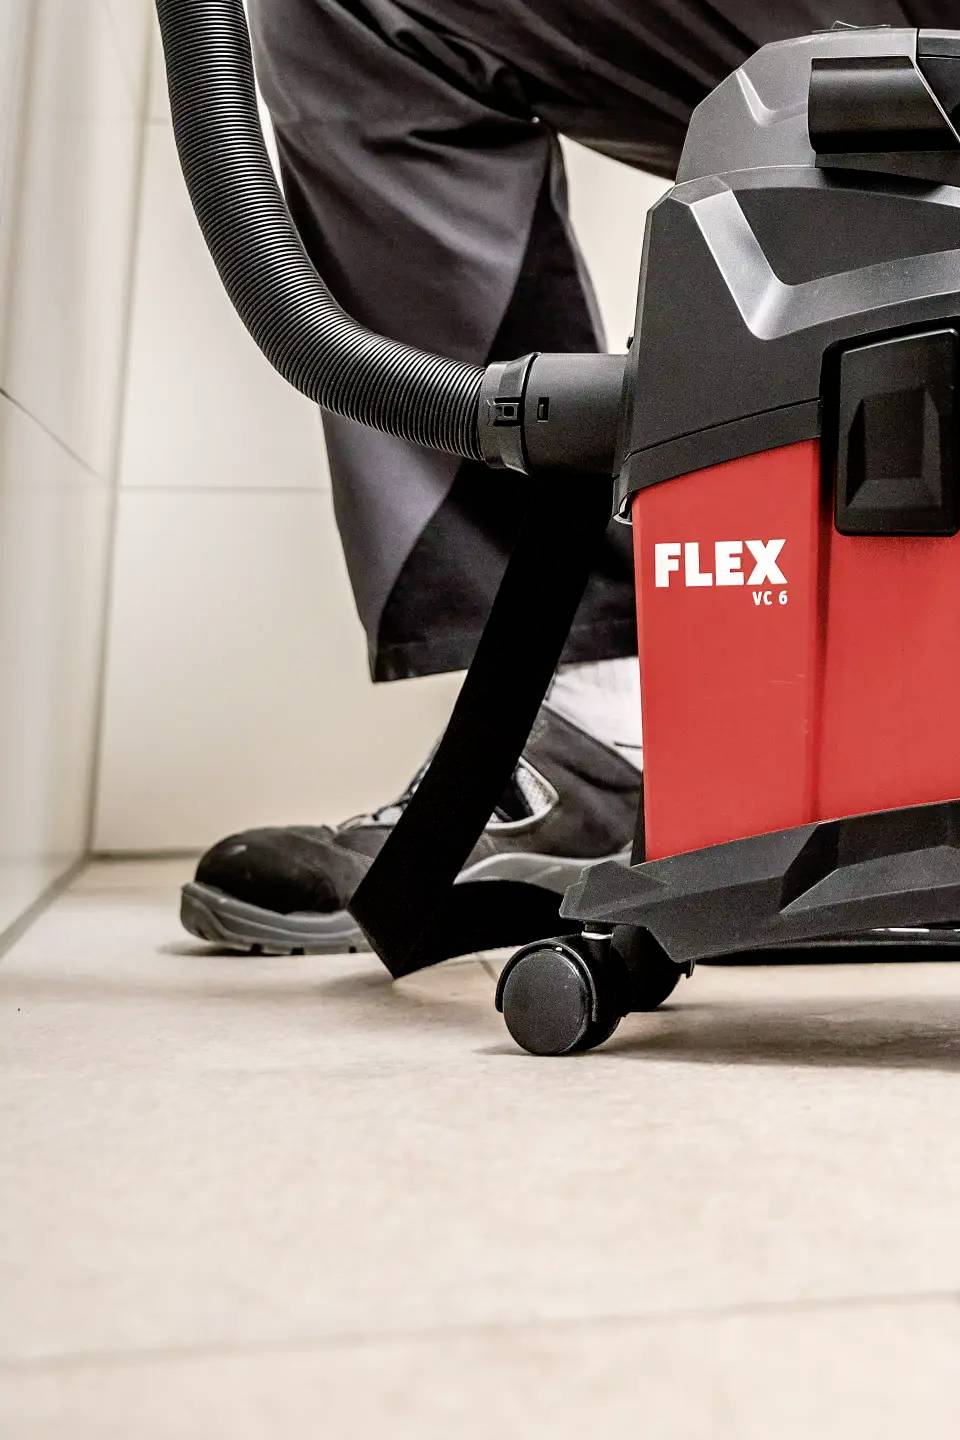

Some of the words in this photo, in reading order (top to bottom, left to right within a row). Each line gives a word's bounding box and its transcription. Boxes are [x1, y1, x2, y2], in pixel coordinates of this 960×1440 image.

[654, 539, 788, 588] FLEX
[752, 591, 773, 606] VC
[778, 590, 788, 605] 6
